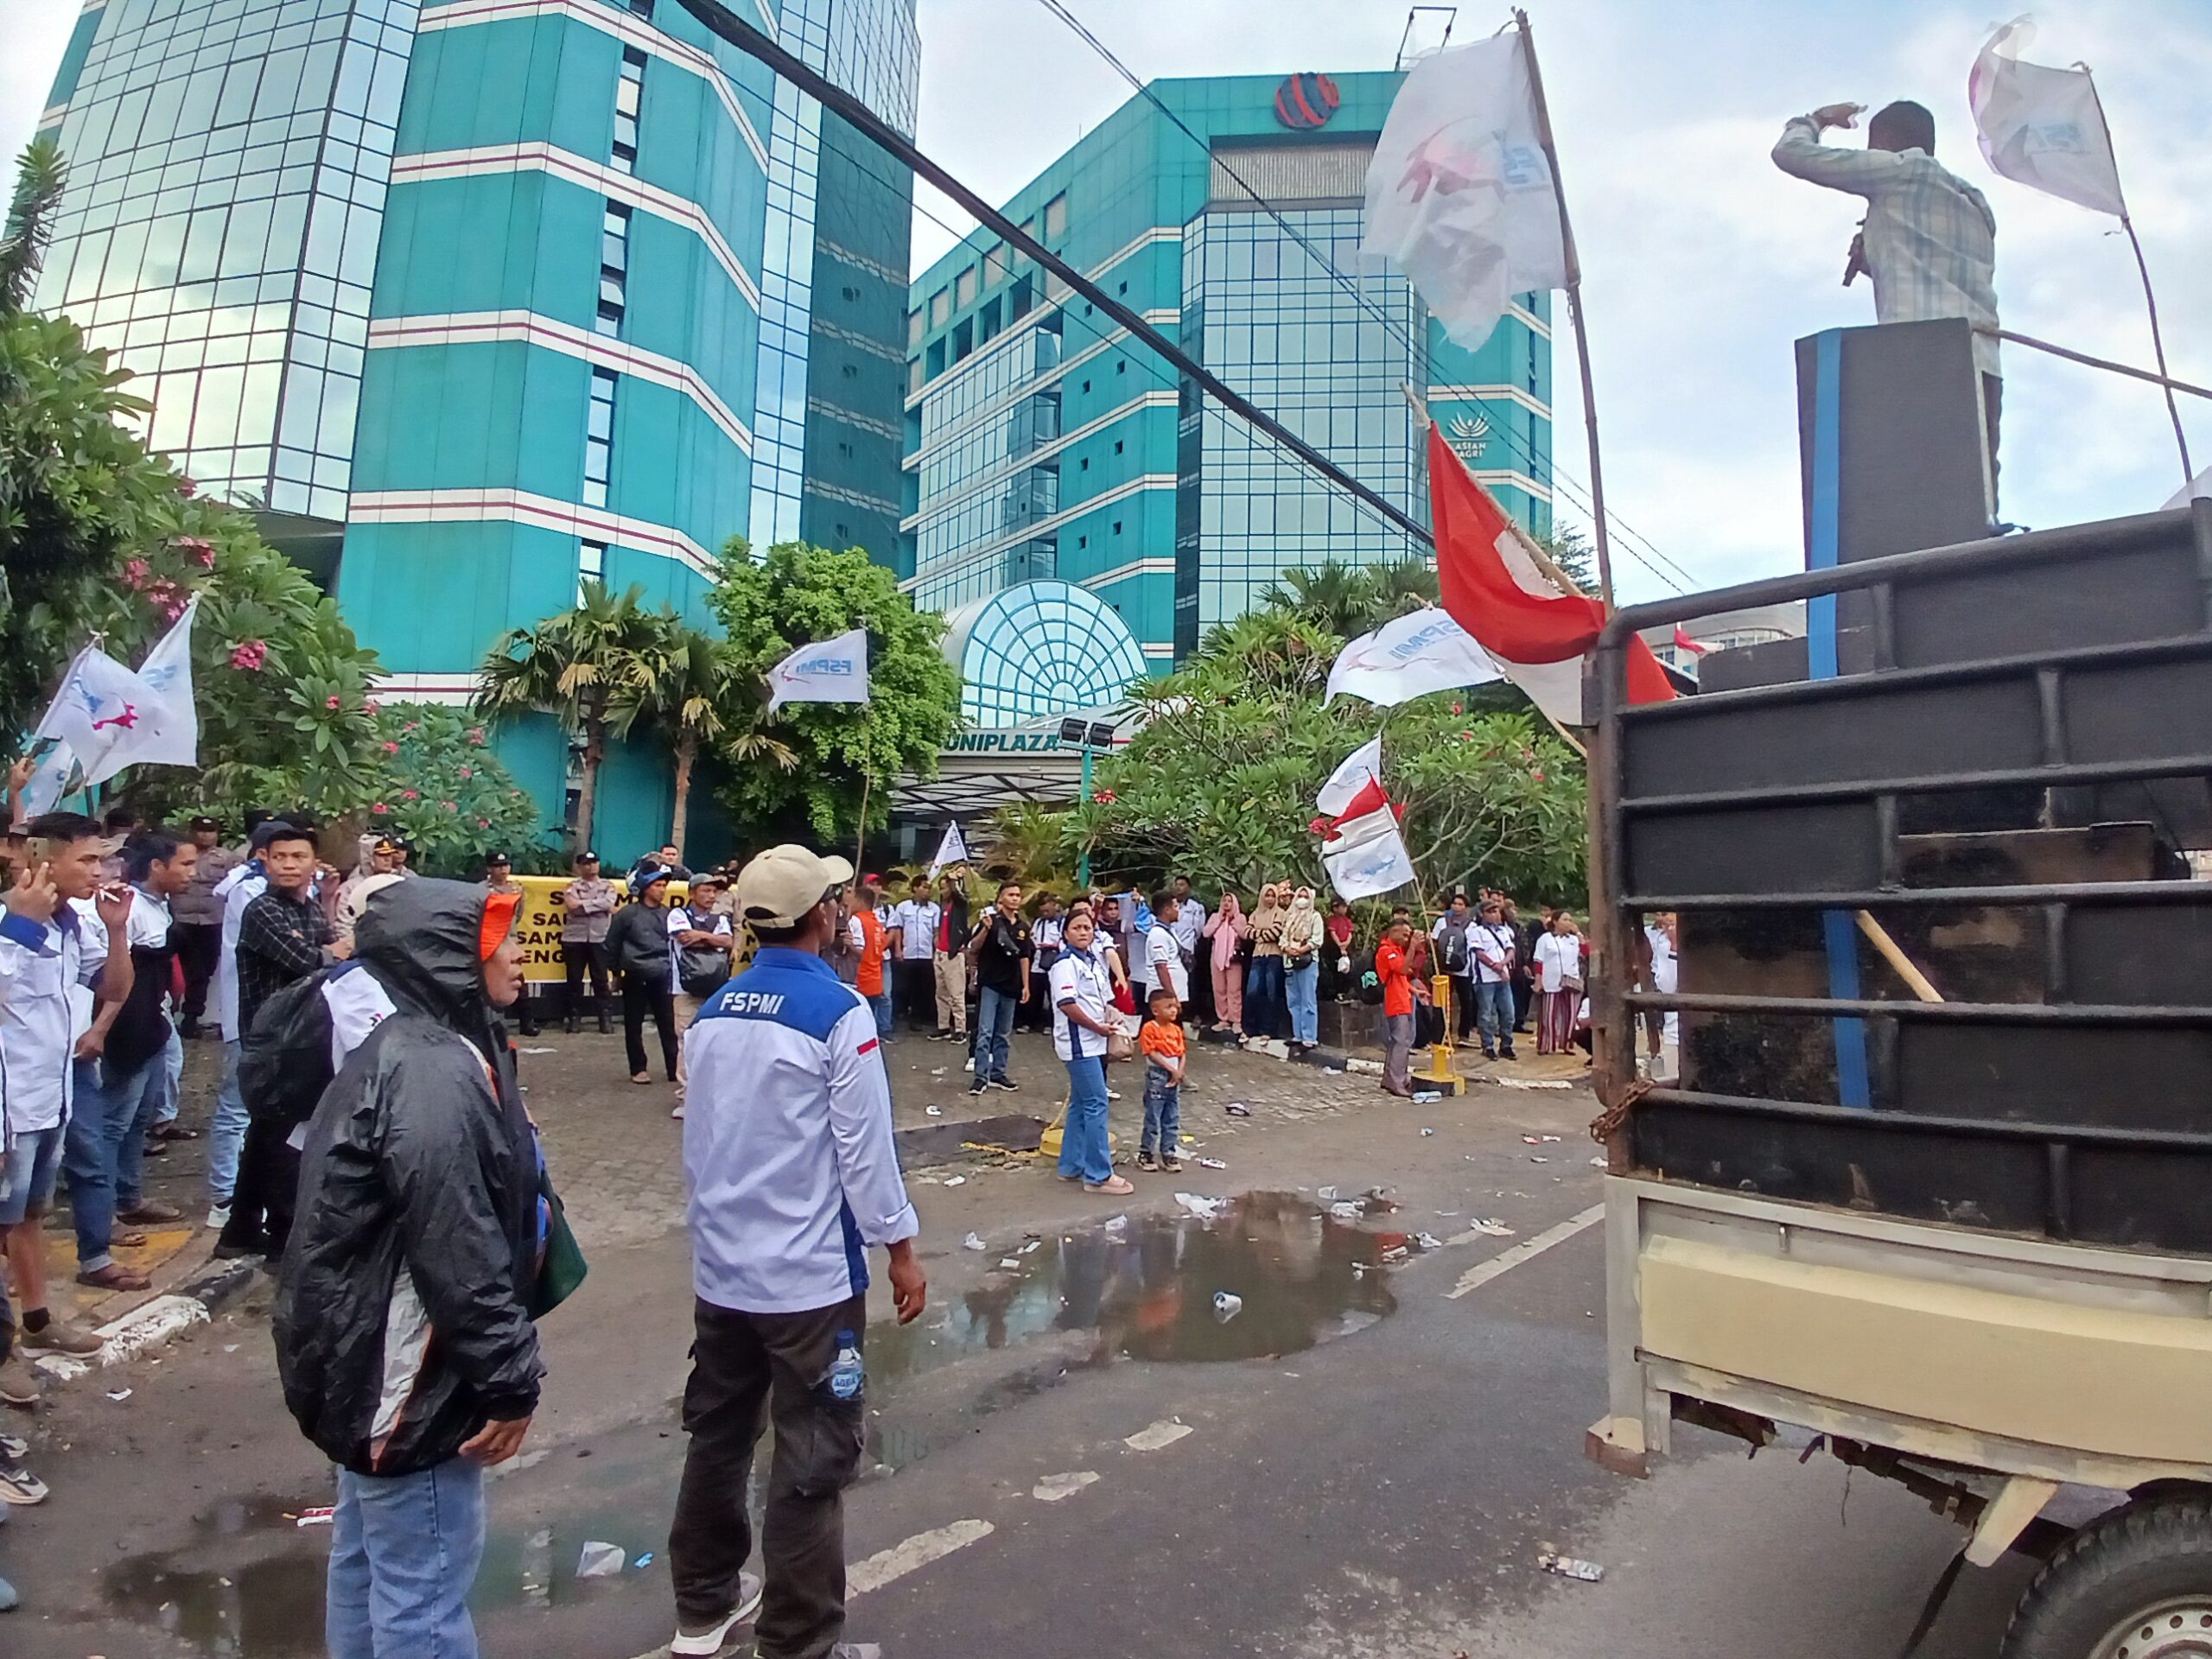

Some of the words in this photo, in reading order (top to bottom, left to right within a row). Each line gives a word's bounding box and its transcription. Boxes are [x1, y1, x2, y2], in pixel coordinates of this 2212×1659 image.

[1455, 442, 1486, 450] ASIAN
[1459, 449, 1483, 458] AGRI
[945, 733, 1058, 753] UNIPLAZA
[719, 991, 785, 1014] FSPMI
